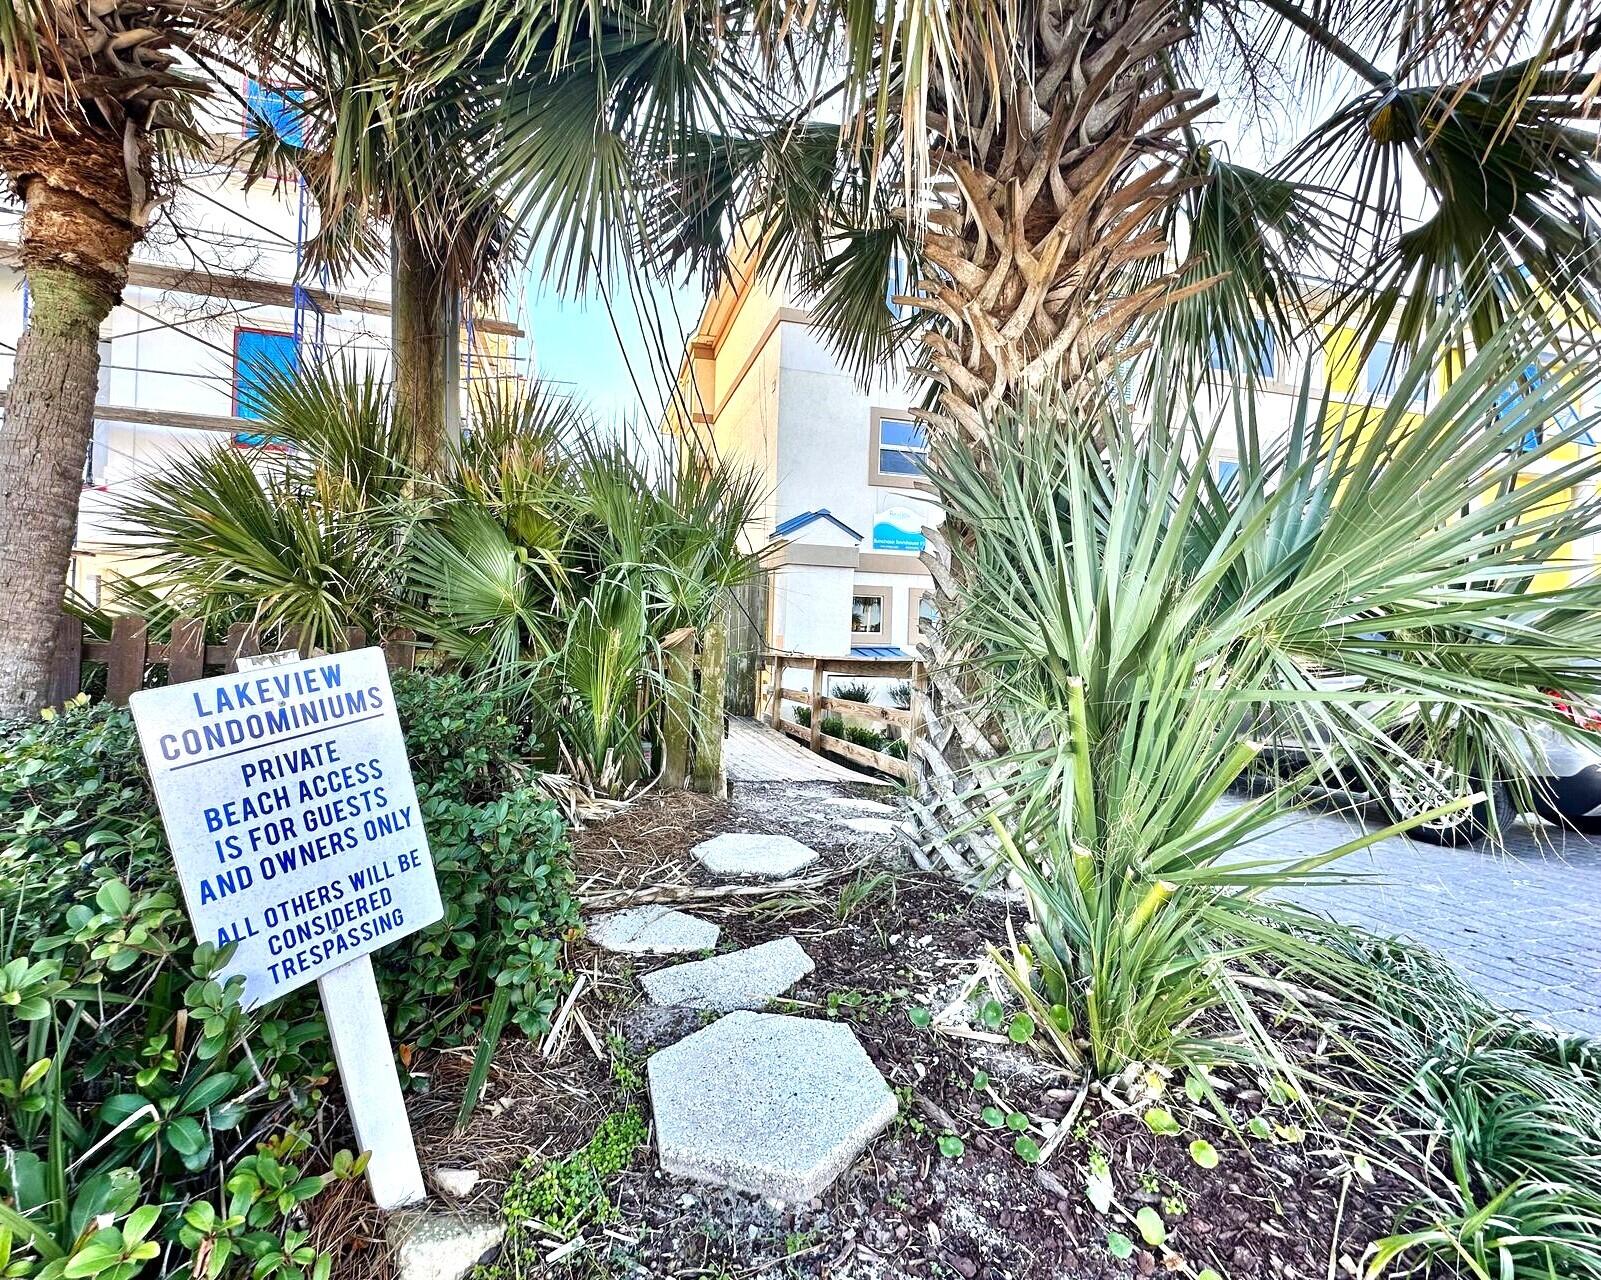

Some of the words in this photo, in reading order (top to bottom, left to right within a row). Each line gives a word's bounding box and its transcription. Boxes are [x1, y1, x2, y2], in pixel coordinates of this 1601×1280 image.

[160, 687, 383, 760] CONDOMINIUMS
[193, 664, 340, 717] LAKEVIEW
[204, 786, 291, 833] BEACH
[299, 759, 382, 804] ACCESS
[241, 740, 340, 788] PRIVATE
[200, 866, 253, 905] AND
[260, 827, 358, 881] OWNERS
[364, 806, 411, 842] ONLY
[215, 835, 242, 864] IS
[248, 817, 298, 852] FOR
[303, 787, 388, 832] GUESTS
[216, 917, 260, 948] ALL
[264, 880, 344, 928] OTHERS
[349, 861, 395, 892] WILL
[398, 849, 422, 873] BE
[268, 887, 393, 956] CONSIDERED
[267, 908, 404, 985] TRESPASSING
